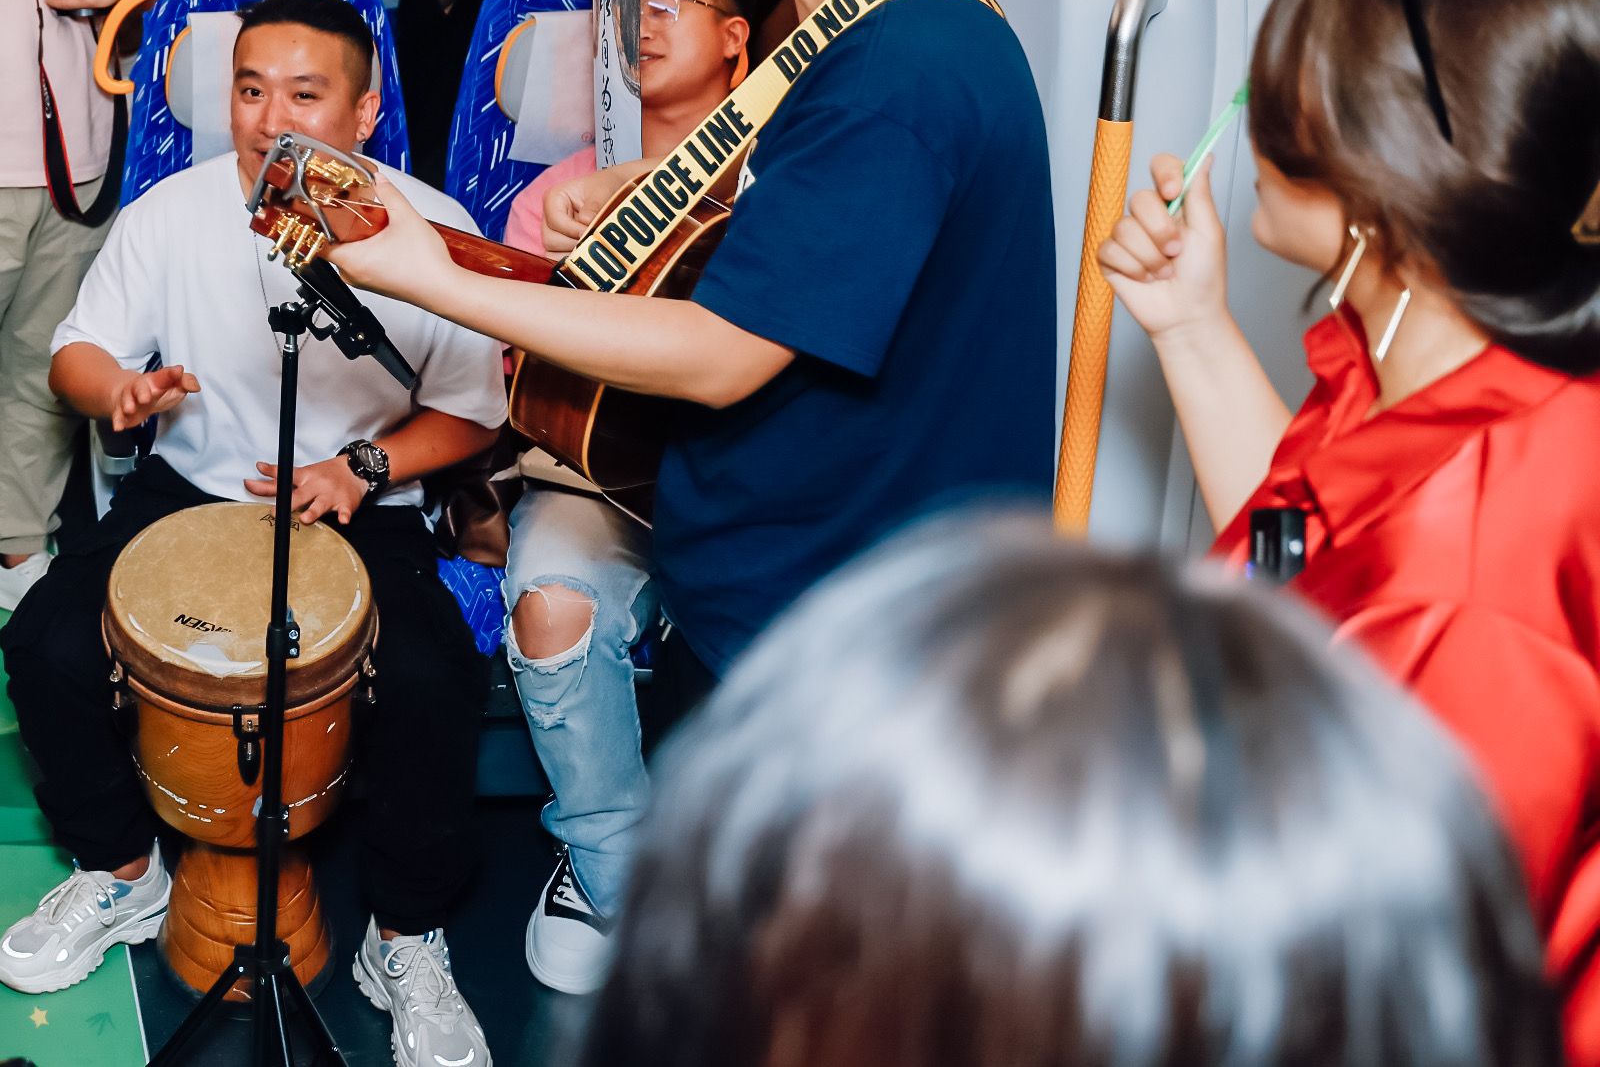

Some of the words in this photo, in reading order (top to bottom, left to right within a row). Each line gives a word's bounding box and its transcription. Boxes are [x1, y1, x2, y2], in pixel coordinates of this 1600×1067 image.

[599, 154, 704, 265] POLICE
[697, 99, 755, 179] LINE
[771, 29, 819, 85] DO
